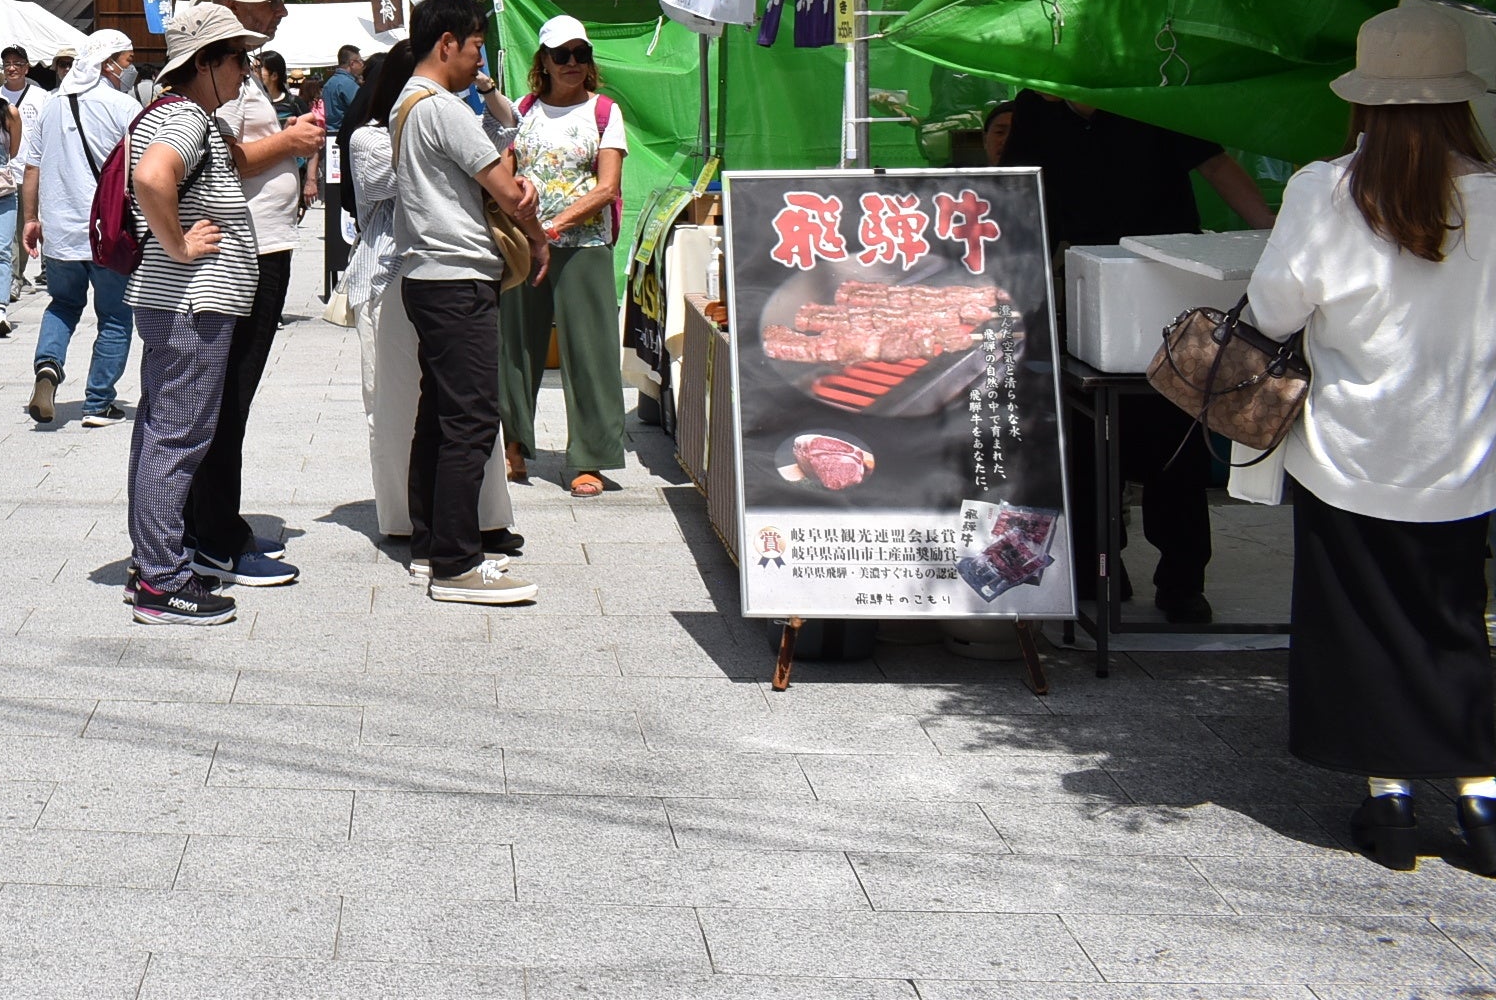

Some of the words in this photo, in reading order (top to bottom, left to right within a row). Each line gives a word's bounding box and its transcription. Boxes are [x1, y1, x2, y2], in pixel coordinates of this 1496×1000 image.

[771, 190, 1001, 274] 飛騨牛
[998, 304, 1023, 442] 澄んだ空気と清らかな水、
[983, 328, 1007, 480] 飛騨の自然の中で育まれた、
[969, 389, 989, 492] 飛騨牛をあなたに。
[759, 530, 782, 553] 賞
[790, 528, 956, 544] 岐阜県観光連盟会長賞
[960, 508, 979, 549] 飛騨牛
[791, 546, 958, 563] 岐阜県高山市土産品奨励賞
[791, 565, 959, 581] 岐阜県飛騨・美濃すぐれもの認定
[854, 592, 952, 606] 飛騨牛のこもり
